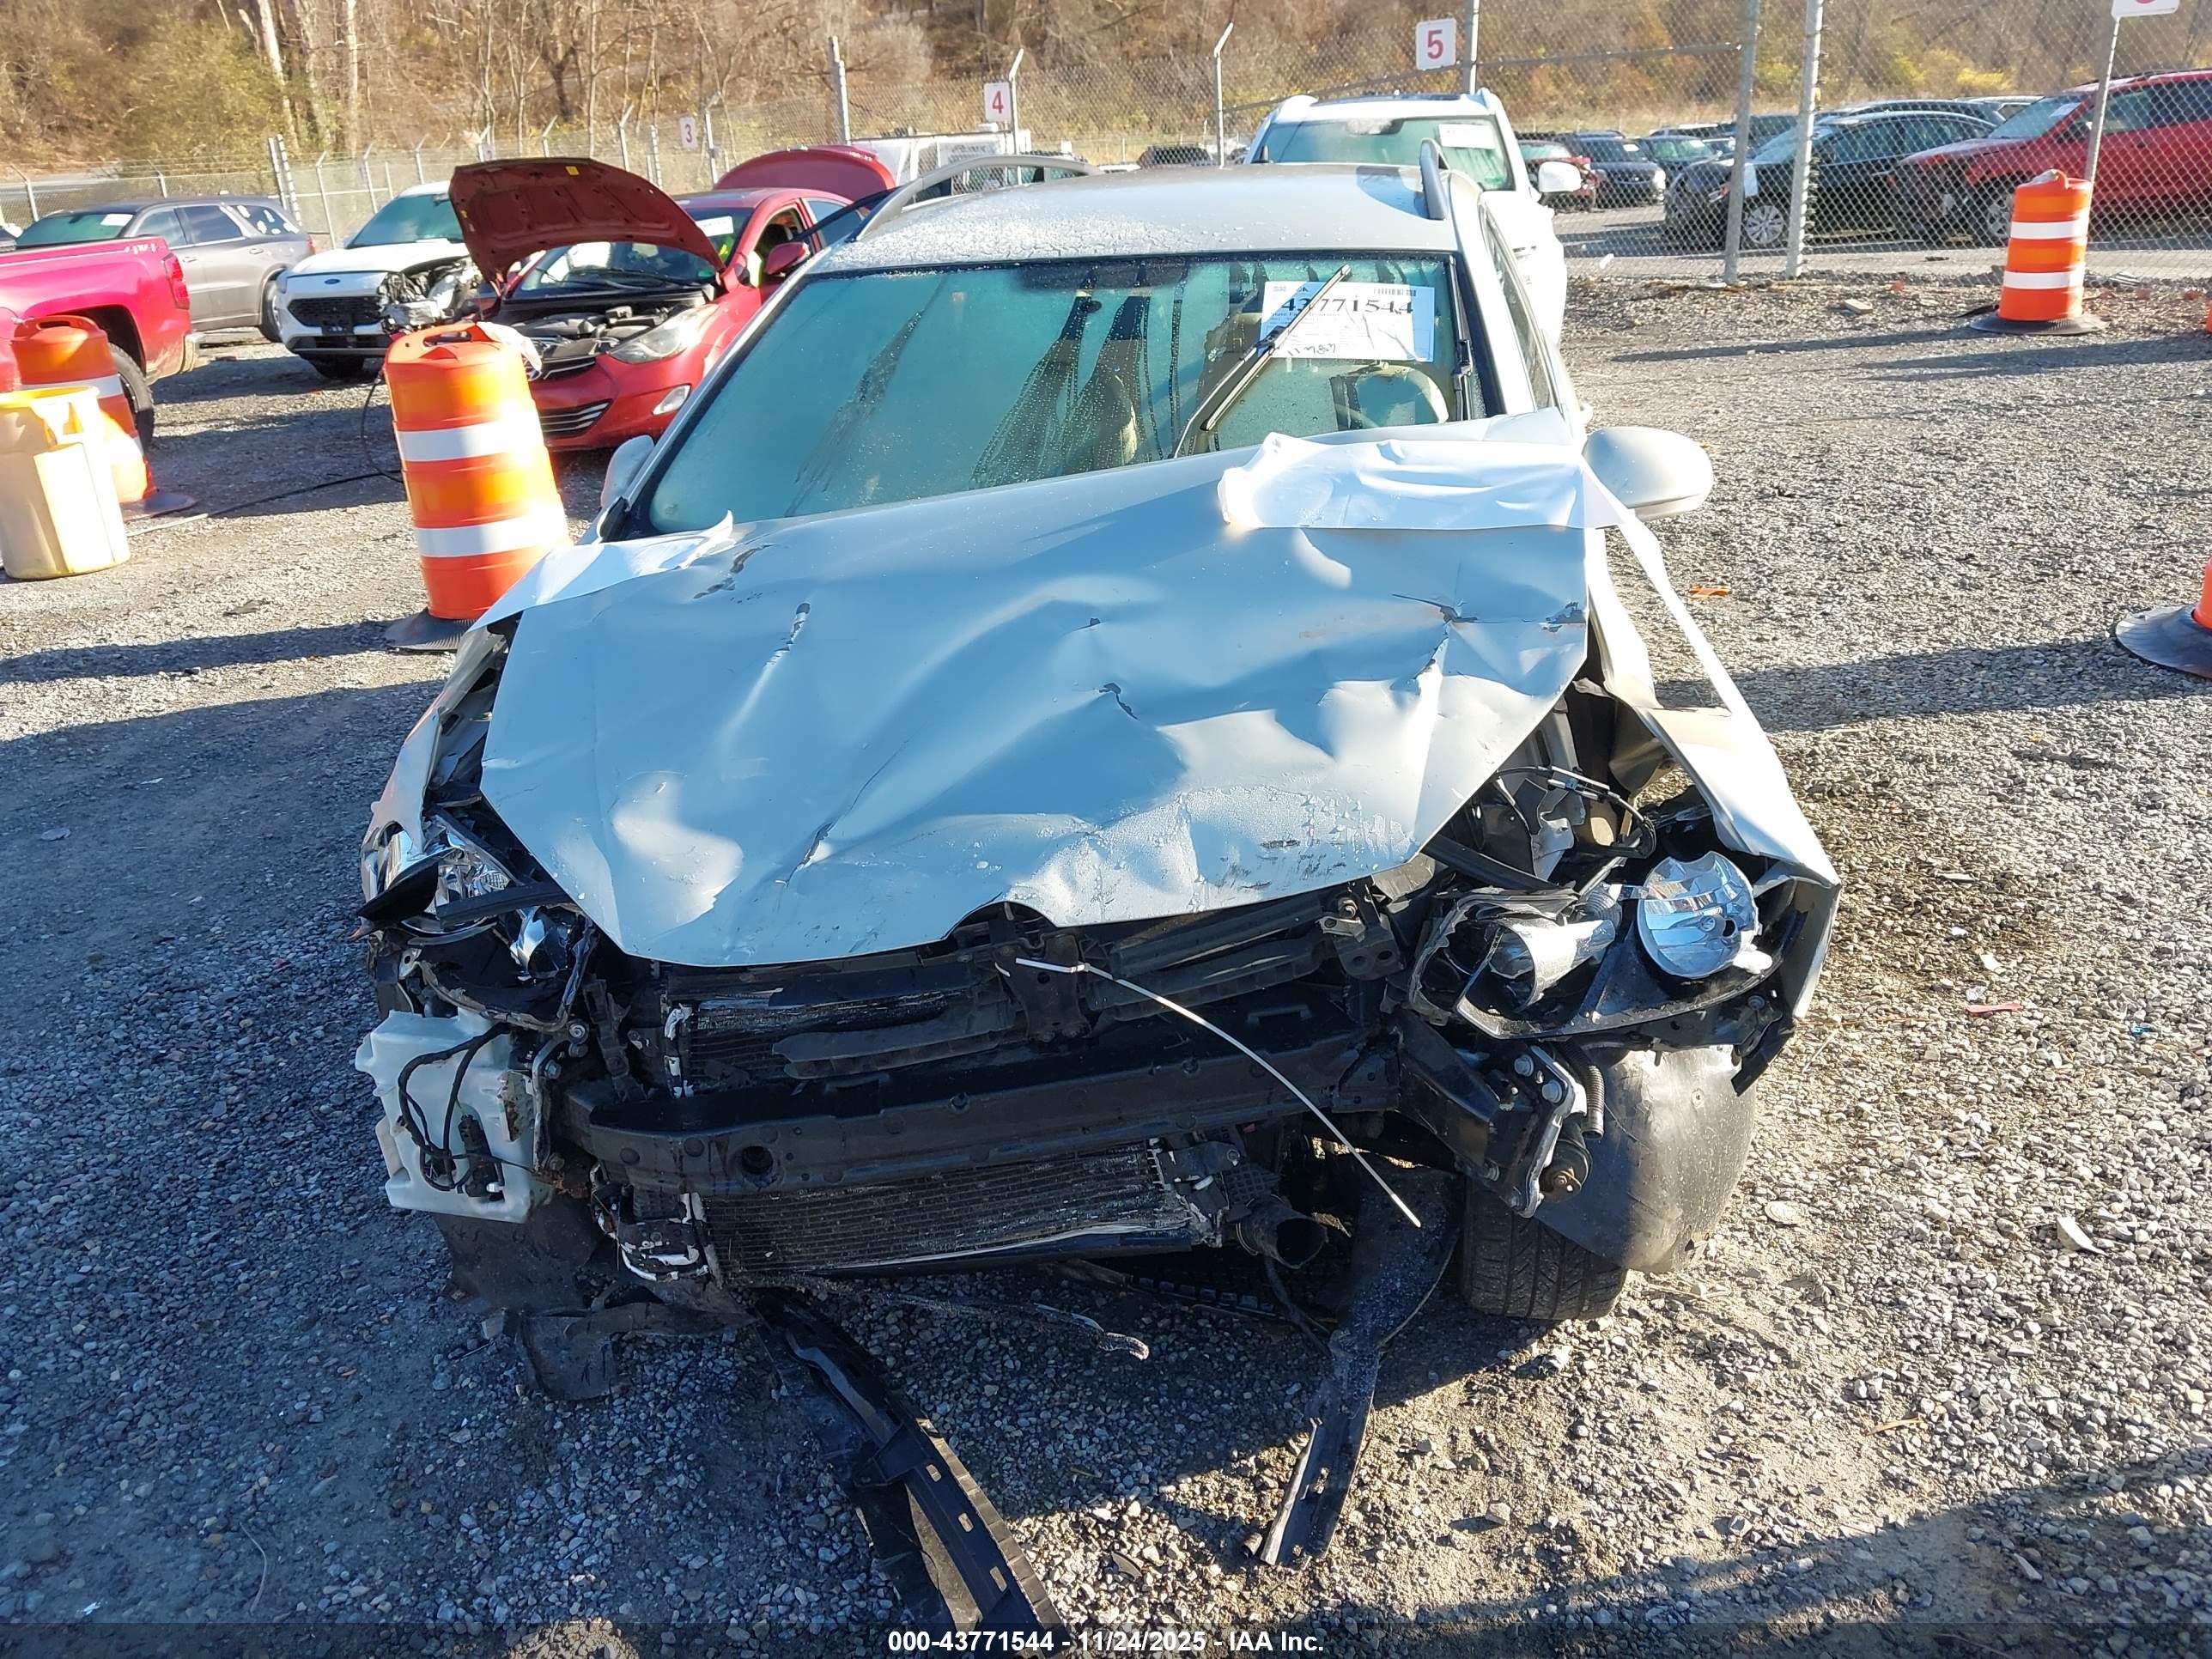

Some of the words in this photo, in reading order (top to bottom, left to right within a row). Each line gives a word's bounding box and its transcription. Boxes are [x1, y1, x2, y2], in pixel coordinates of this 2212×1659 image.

[1427, 29, 1443, 59] 5
[992, 90, 1004, 113] 4
[684, 124, 693, 143] 3
